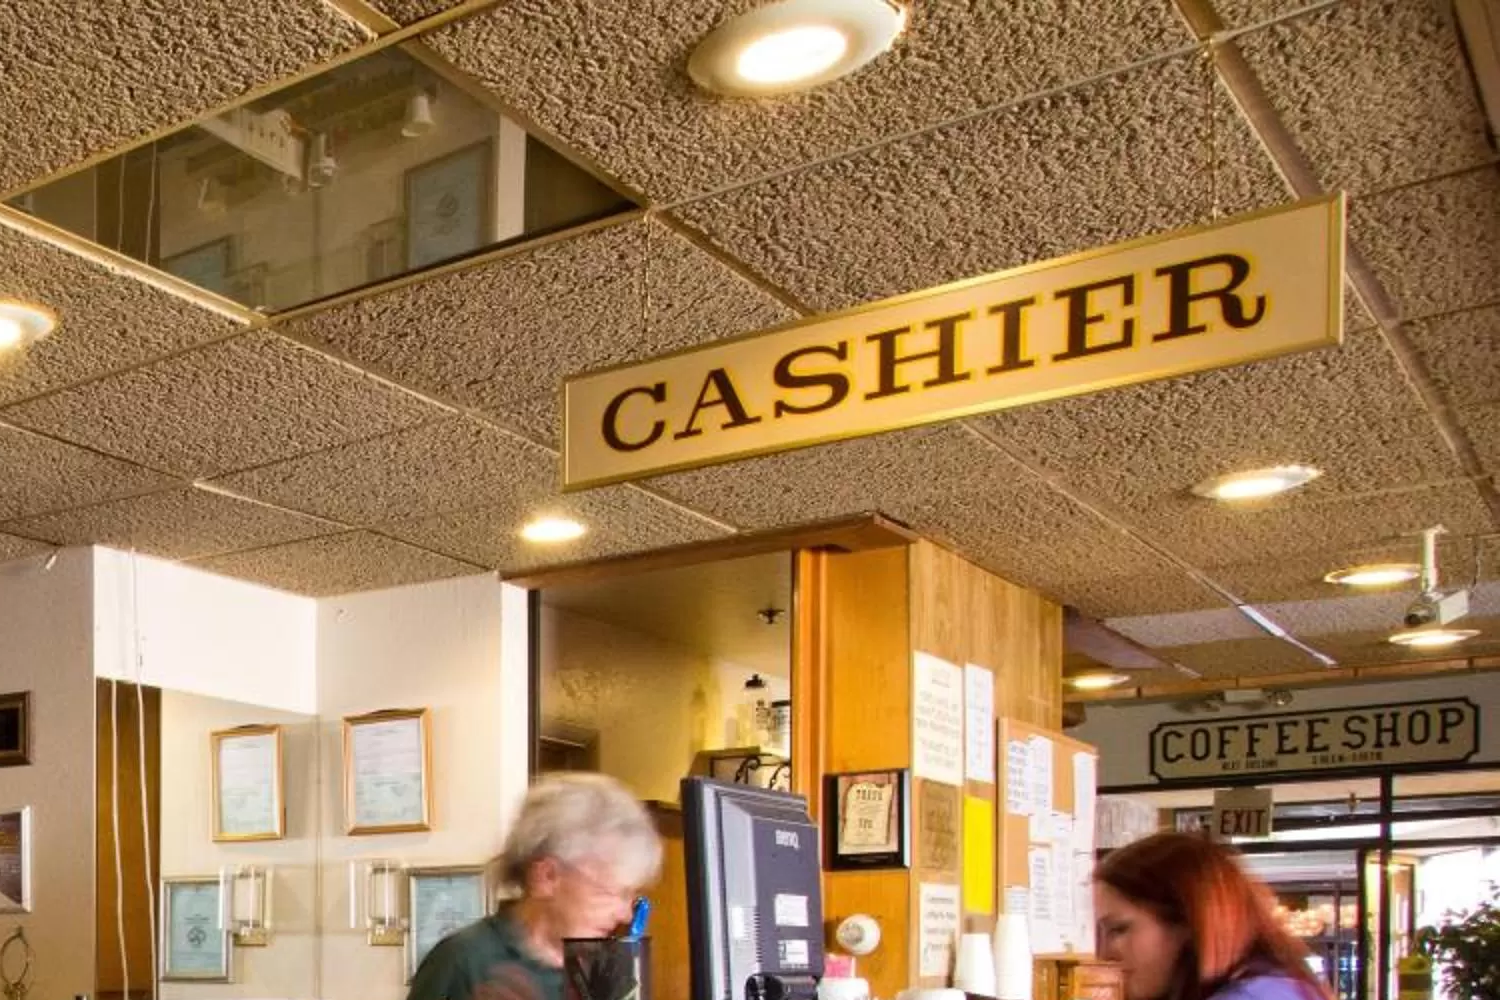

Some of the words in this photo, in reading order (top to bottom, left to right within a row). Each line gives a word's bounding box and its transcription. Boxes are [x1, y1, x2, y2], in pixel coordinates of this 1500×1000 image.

[600, 251, 1267, 453] CASHIER
[1161, 718, 1330, 763] COFFEE
[1342, 707, 1466, 750] SHOP
[1219, 807, 1267, 835] EXIT
